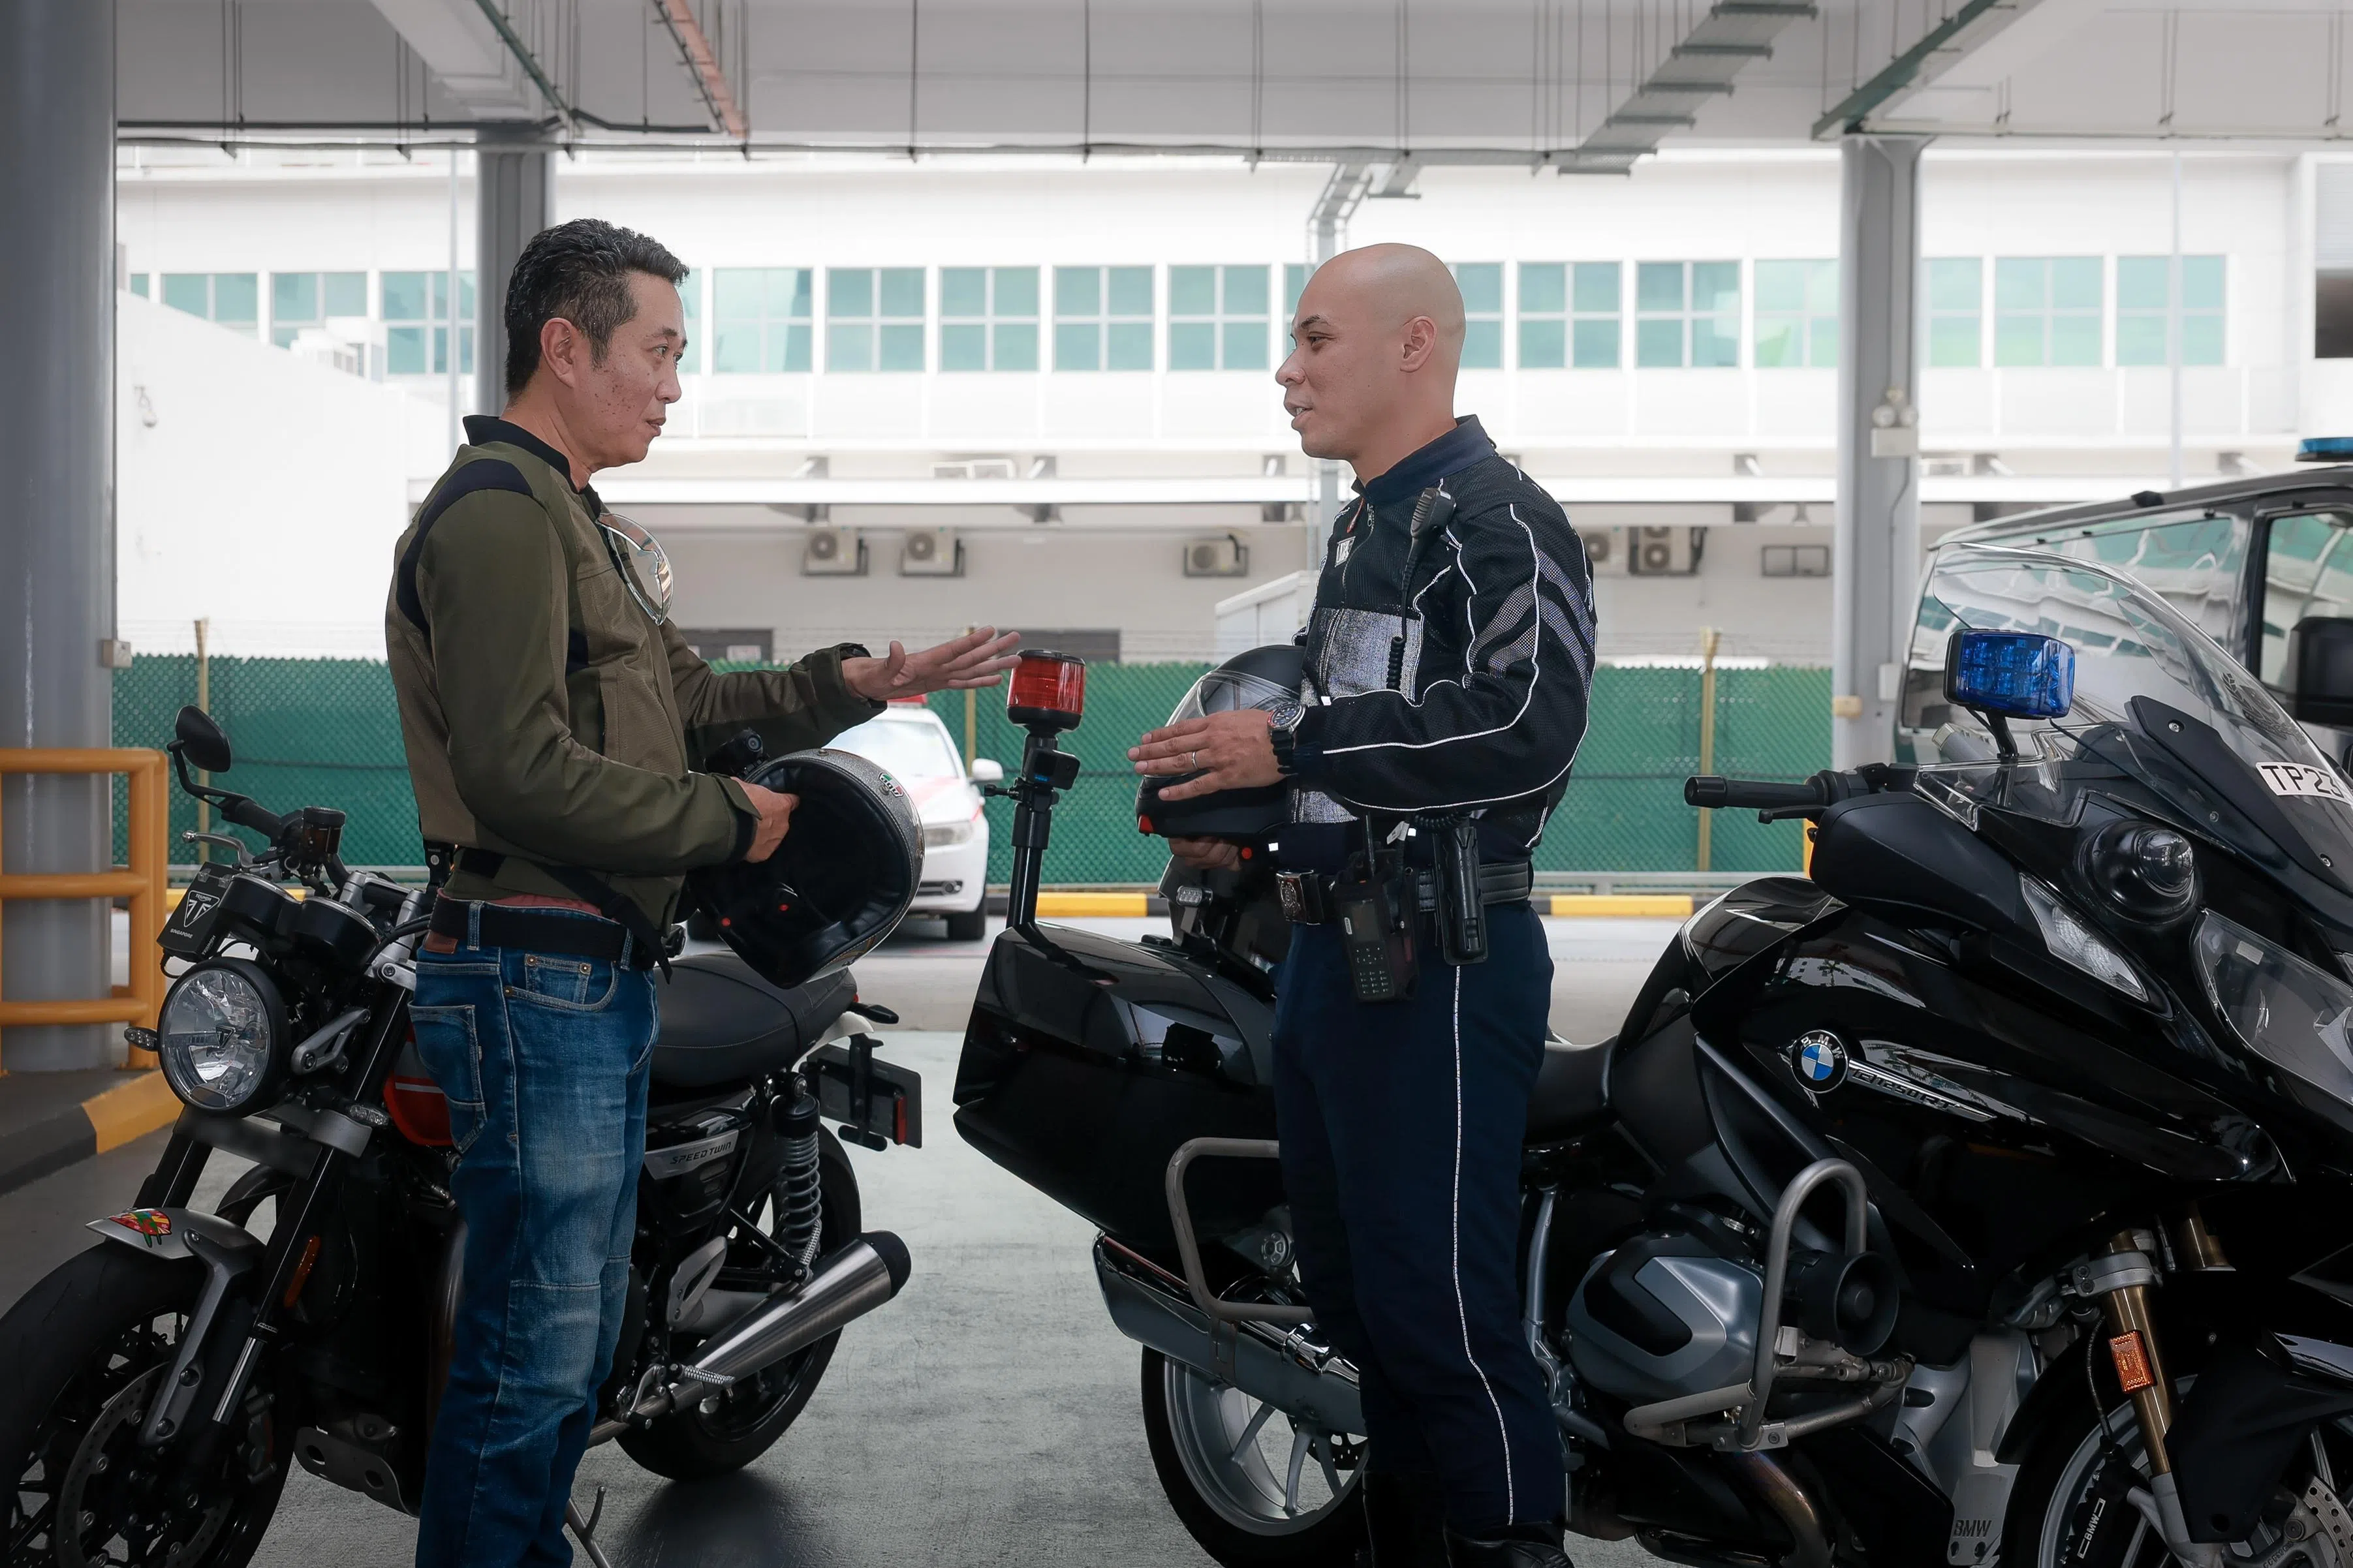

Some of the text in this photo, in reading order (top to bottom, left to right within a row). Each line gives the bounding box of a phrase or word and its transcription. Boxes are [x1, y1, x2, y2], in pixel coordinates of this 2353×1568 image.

[195, 893, 212, 902] TRIUMPH
[170, 928, 193, 939] SINGAPORE
[202, 935, 216, 955] TRIUMPH
[1801, 1034, 1844, 1059] BMW
[670, 1142, 732, 1164] SPEED TWIN
[1954, 1519, 1993, 1537] BMW
[2084, 1513, 2100, 1541] BMW
